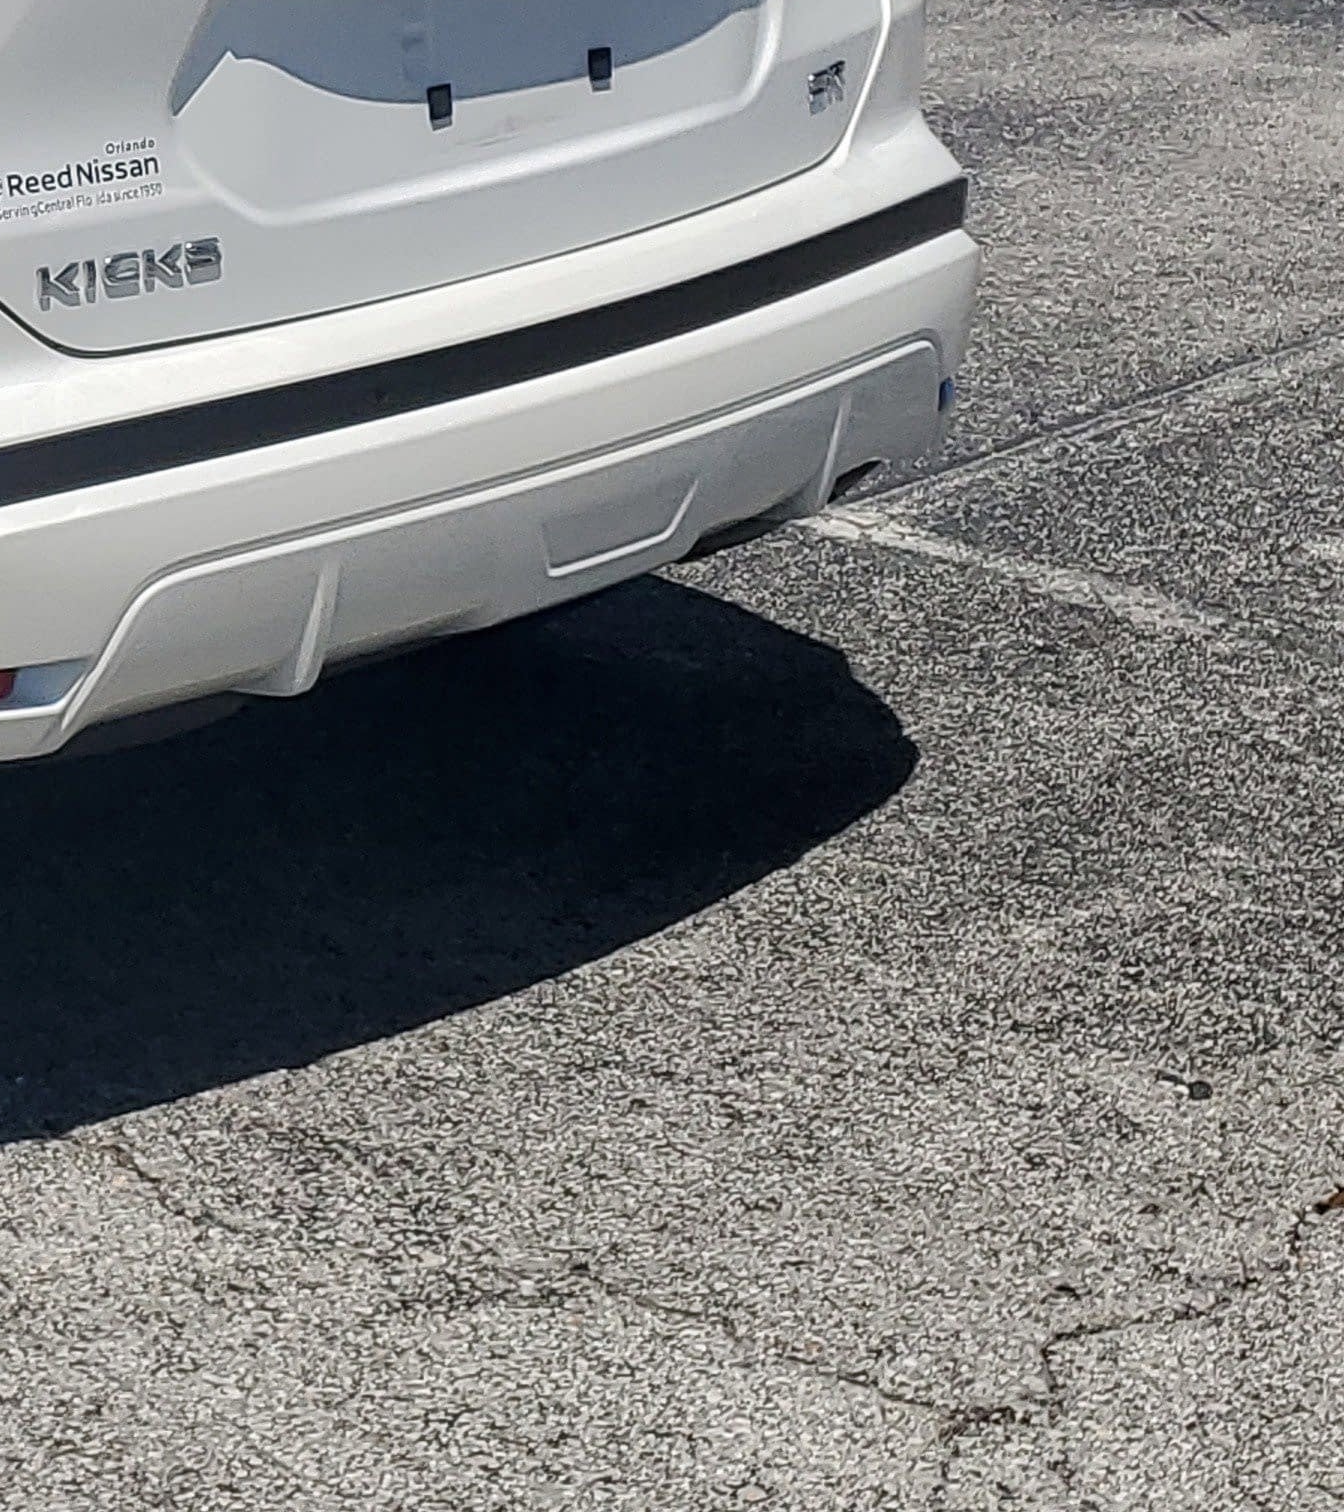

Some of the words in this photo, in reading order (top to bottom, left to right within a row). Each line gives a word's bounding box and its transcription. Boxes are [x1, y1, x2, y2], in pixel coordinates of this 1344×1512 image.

[105, 137, 155, 155] Orlando
[6, 163, 73, 197] Reed
[75, 156, 160, 187] Nissan
[37, 196, 75, 215] Central
[77, 191, 112, 208] Floida
[35, 237, 223, 311] KICKS
